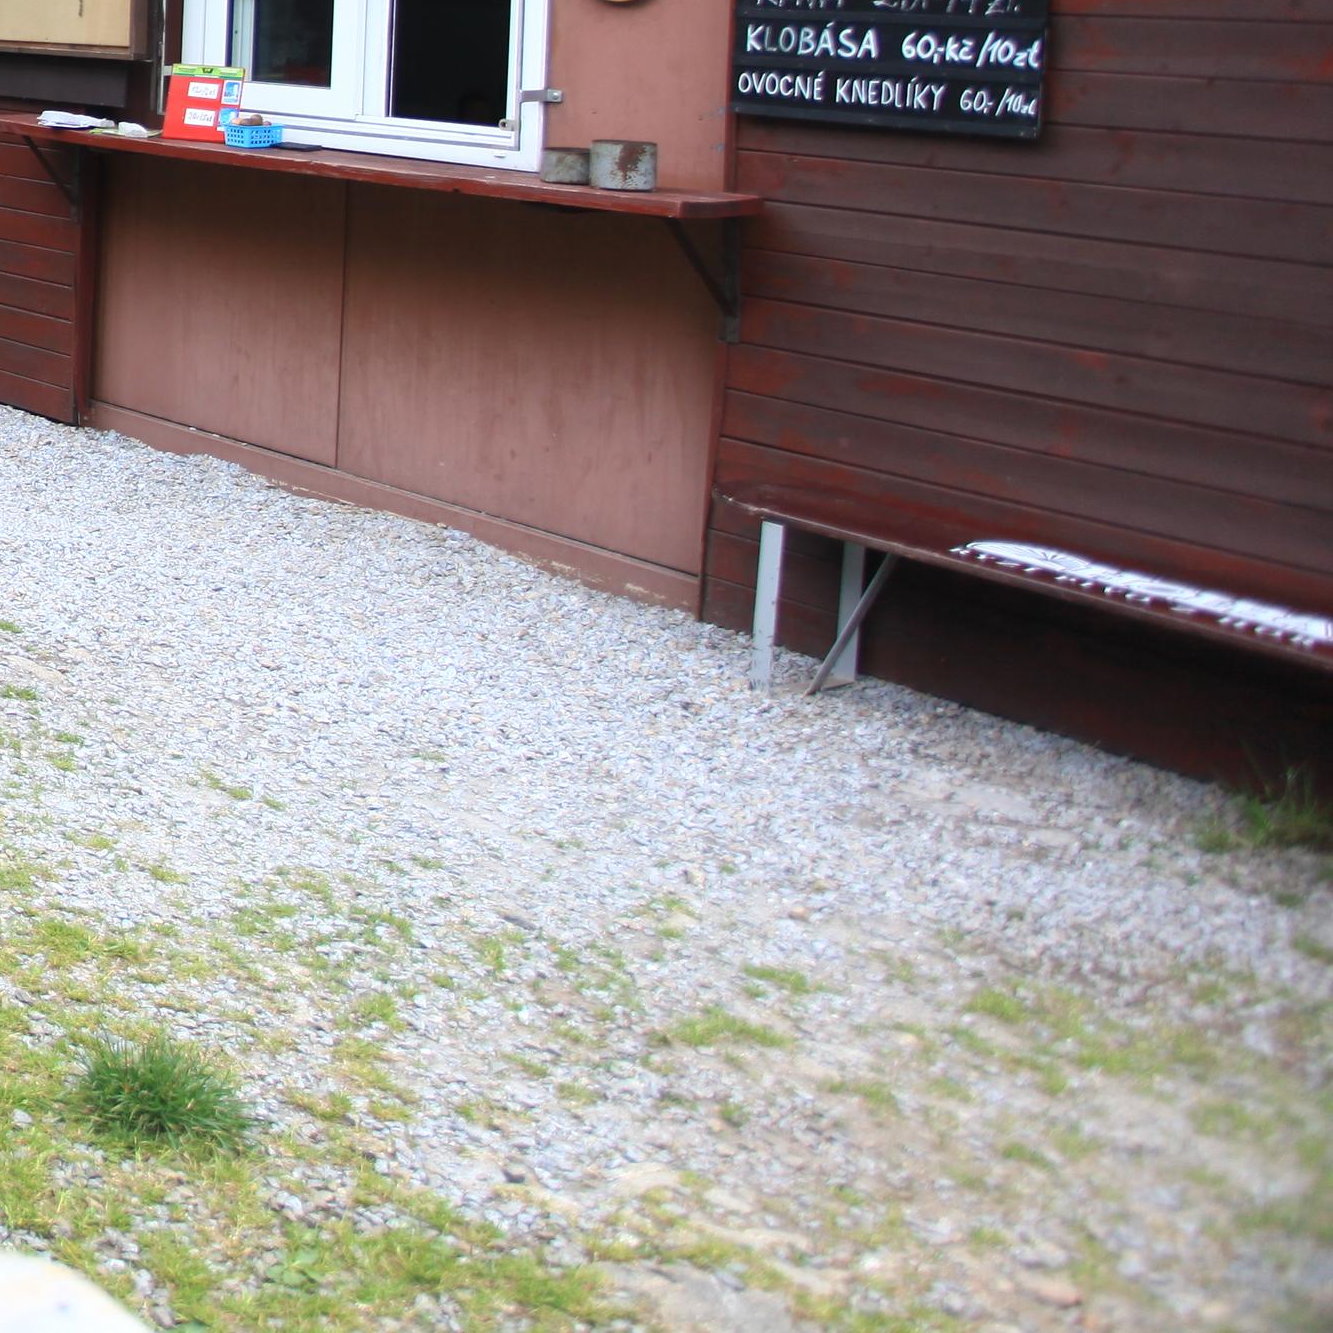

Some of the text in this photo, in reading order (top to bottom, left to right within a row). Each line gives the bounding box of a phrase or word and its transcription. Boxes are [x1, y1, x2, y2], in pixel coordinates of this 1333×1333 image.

[745, 21, 880, 59] KLOBÁSA
[737, 69, 826, 101] OVOCNÉ
[834, 76, 947, 112] KNEDLÍKY
